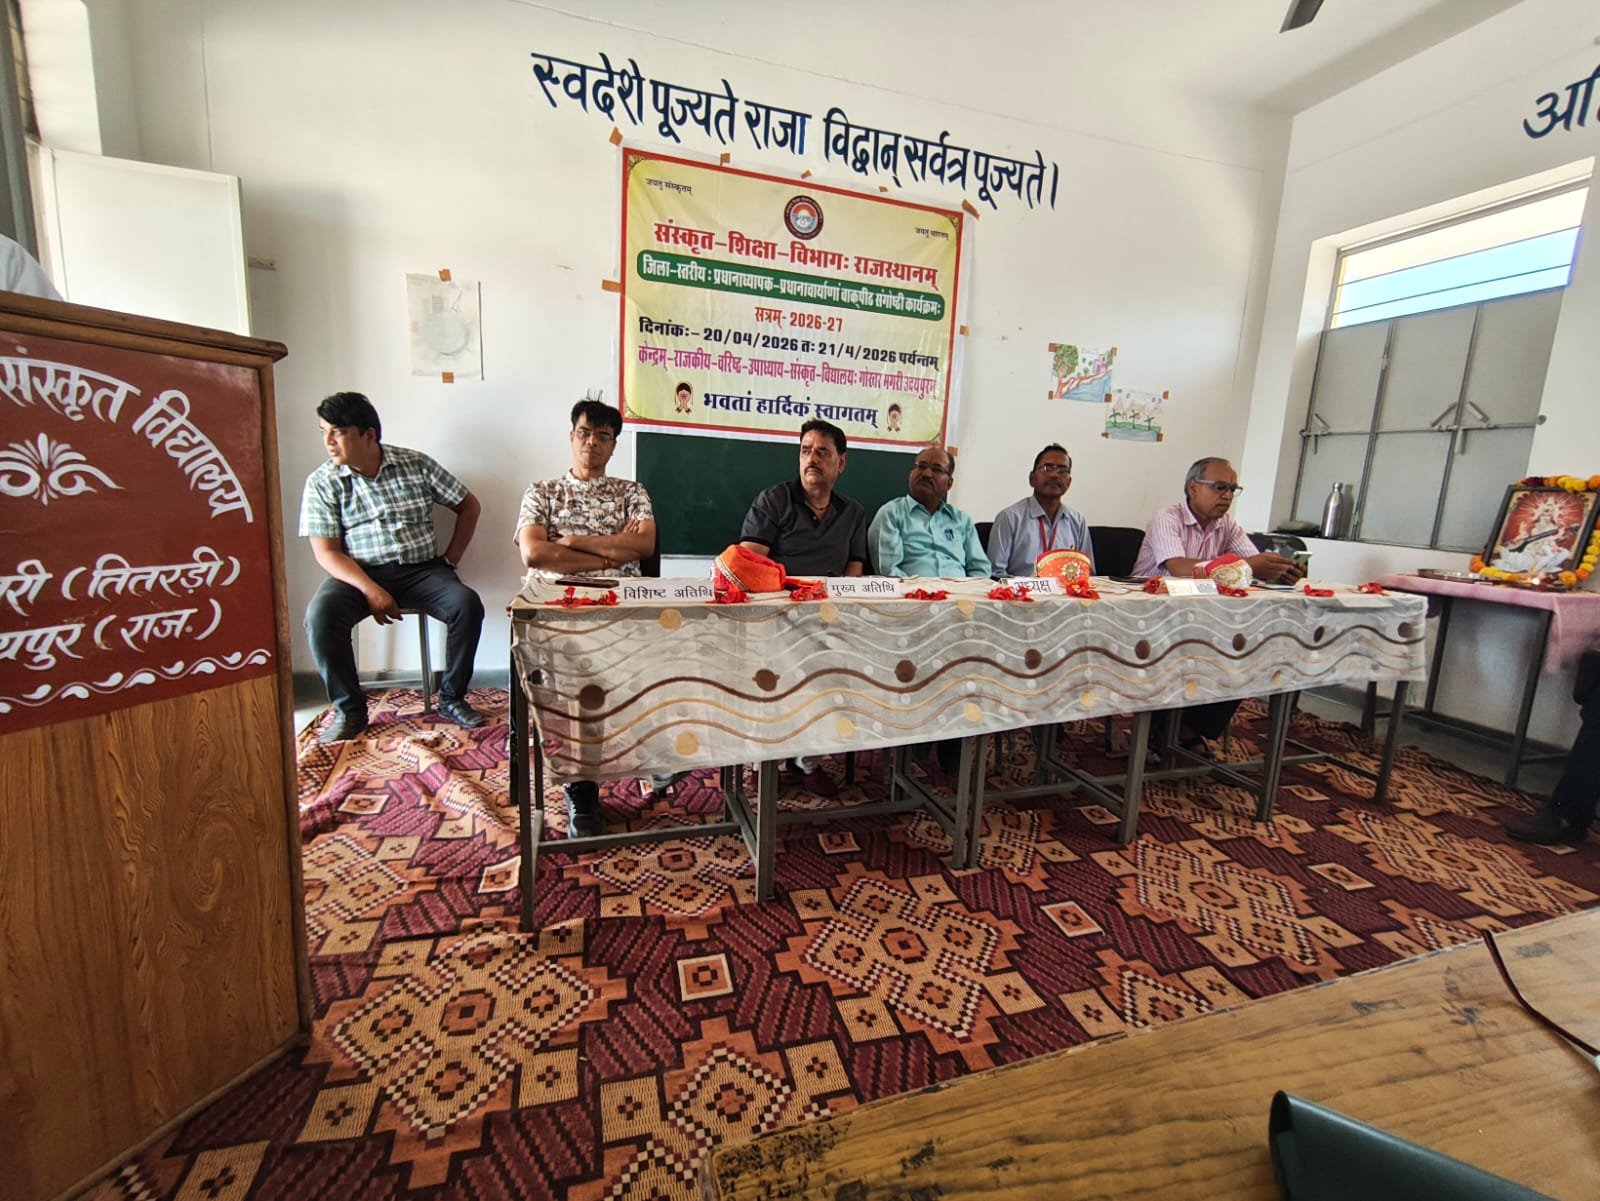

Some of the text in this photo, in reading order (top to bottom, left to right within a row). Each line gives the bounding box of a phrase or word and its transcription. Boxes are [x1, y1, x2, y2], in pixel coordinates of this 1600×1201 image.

[531, 52, 644, 125] स्वदेशे
[649, 79, 739, 144] पूज्यते
[745, 100, 811, 156] राजा
[823, 108, 902, 187] विद्वान्
[904, 126, 970, 190] सर्वत्र
[645, 178, 693, 195] जयतु संस्कृतम्
[854, 256, 938, 290] राजस्थानम्
[790, 312, 843, 332] 2026-27
[704, 328, 798, 351] 20/04/2026
[818, 342, 896, 363] 21/4/2026
[899, 350, 939, 371] पर्यन्तम्
[884, 371, 903, 391] मगरी
[704, 390, 879, 428] भवतां हार्दिकं स्वागतम्
[132, 389, 254, 523] विद्यालय
[624, 585, 713, 599] विशिष्ट अतिथि
[831, 580, 895, 596] मुख्य अतिथि
